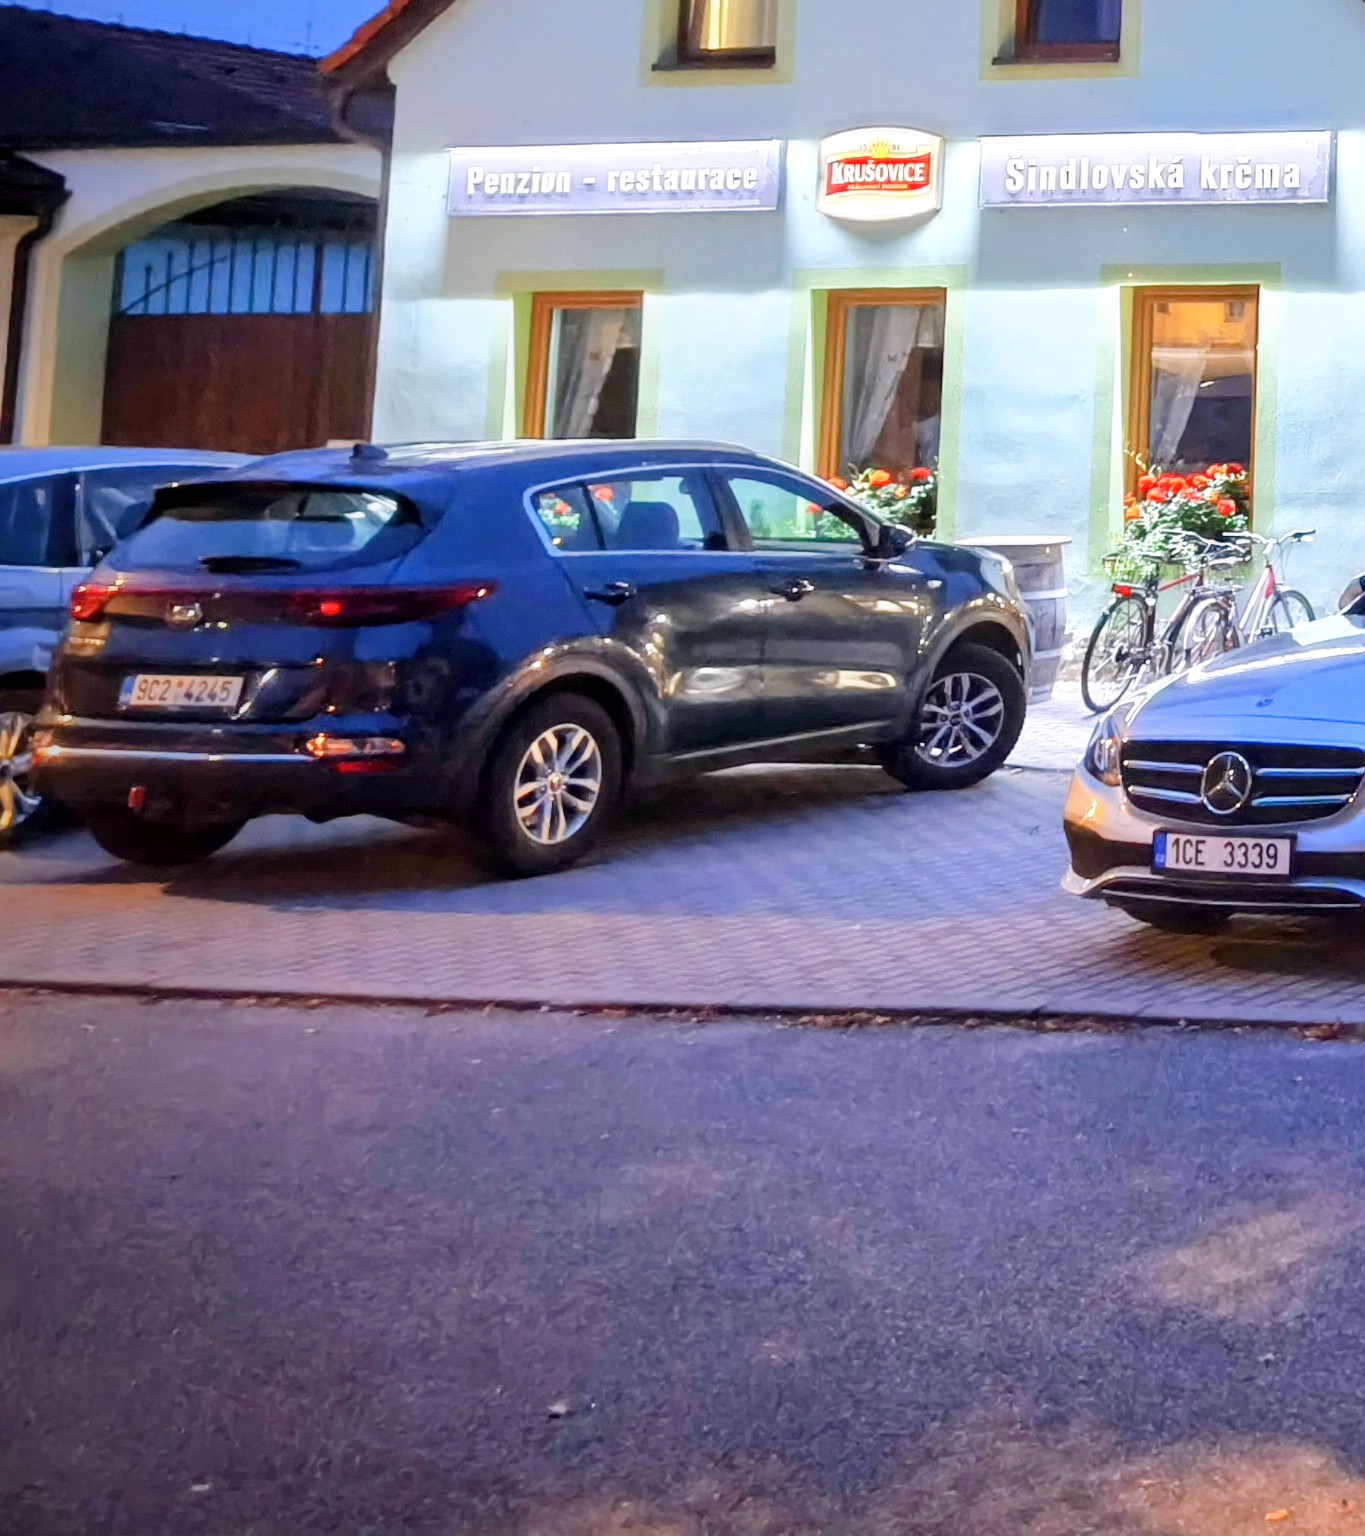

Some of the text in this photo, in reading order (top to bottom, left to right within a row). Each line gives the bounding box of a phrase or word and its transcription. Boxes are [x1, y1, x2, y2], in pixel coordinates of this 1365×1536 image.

[466, 166, 572, 195] Penzion
[607, 164, 759, 193] restaurace
[831, 159, 926, 185] KRUŠOVICE
[1005, 153, 1301, 193] Šindlovská krčma
[136, 678, 233, 703] 9C2 4245
[1171, 837, 1279, 870] 1CE 3339
